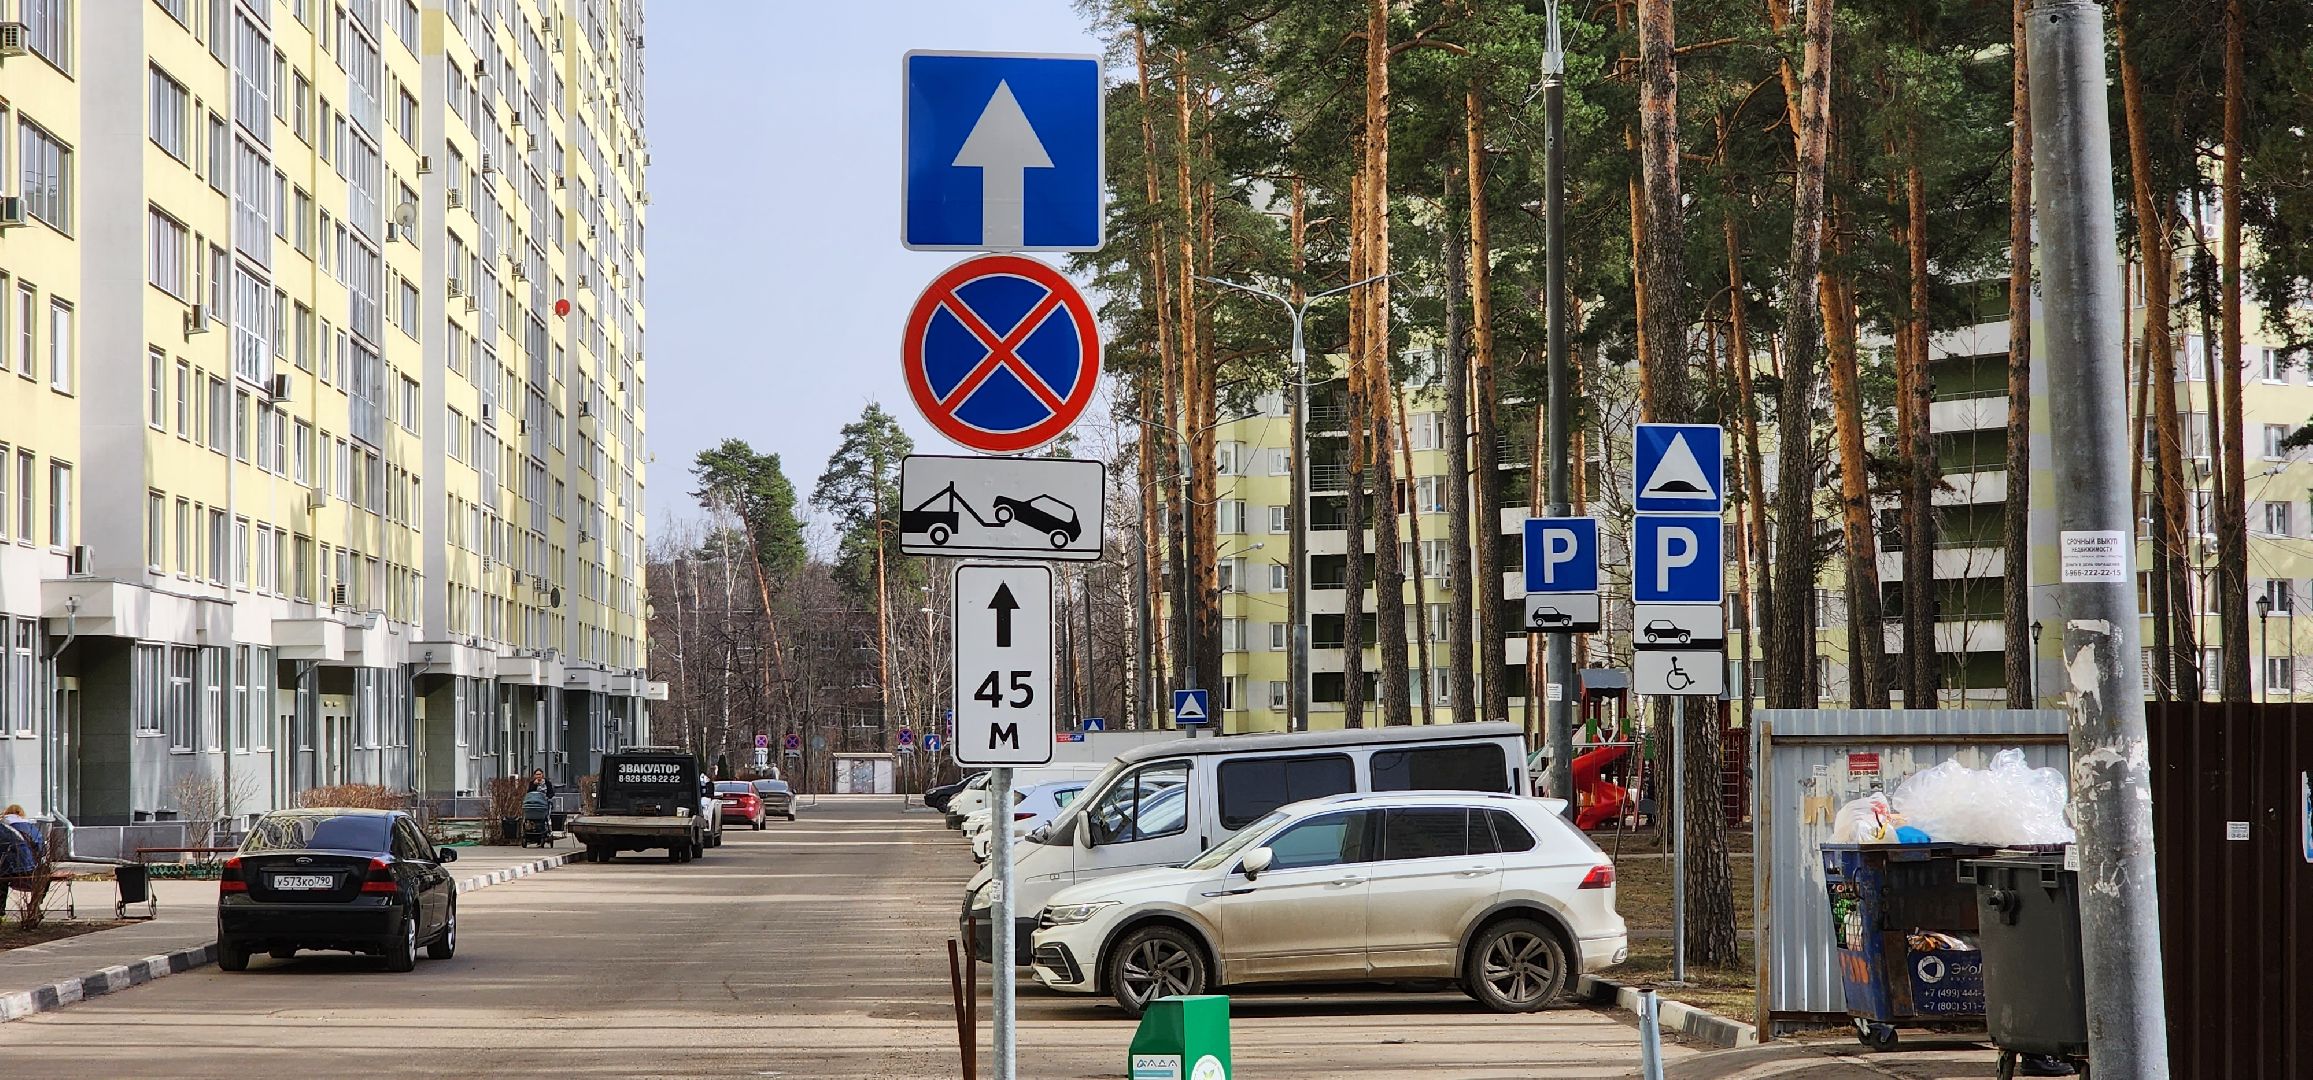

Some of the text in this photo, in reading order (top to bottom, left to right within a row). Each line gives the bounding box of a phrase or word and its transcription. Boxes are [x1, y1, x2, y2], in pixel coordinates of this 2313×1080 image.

[2067, 537, 2118, 545] СРОЧНЫЙ ВЫКУП
[1543, 528, 1578, 584] P
[1657, 526, 1698, 592] P
[974, 671, 1034, 709] 45
[618, 763, 681, 774] ЭВАКУАТОР
[1962, 989, 1985, 997] 444-
